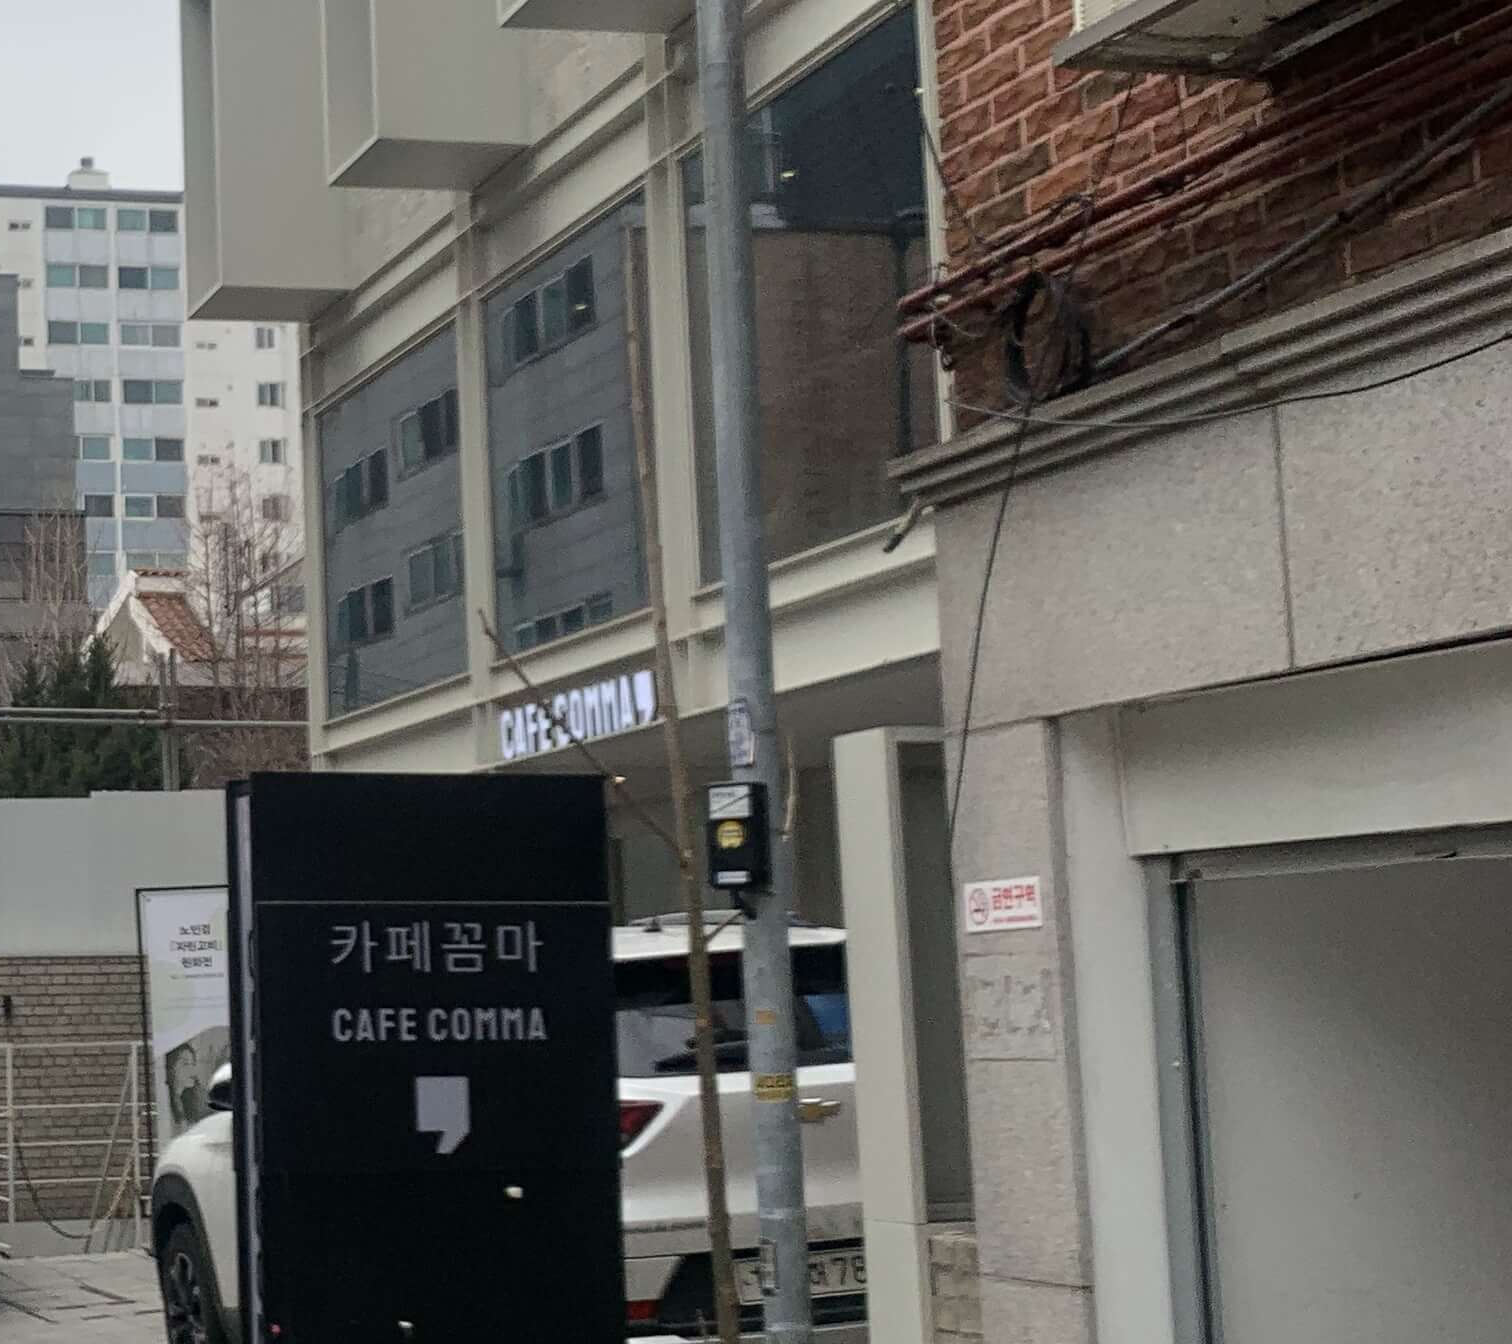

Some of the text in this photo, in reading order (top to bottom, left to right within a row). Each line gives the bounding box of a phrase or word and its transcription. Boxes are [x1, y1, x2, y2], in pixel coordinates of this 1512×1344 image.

[500, 703, 553, 760] CAFE
[992, 884, 1036, 910] 금연구역
[331, 920, 544, 973] 카페꼼마
[332, 1007, 548, 1042] CAFE COMMA
